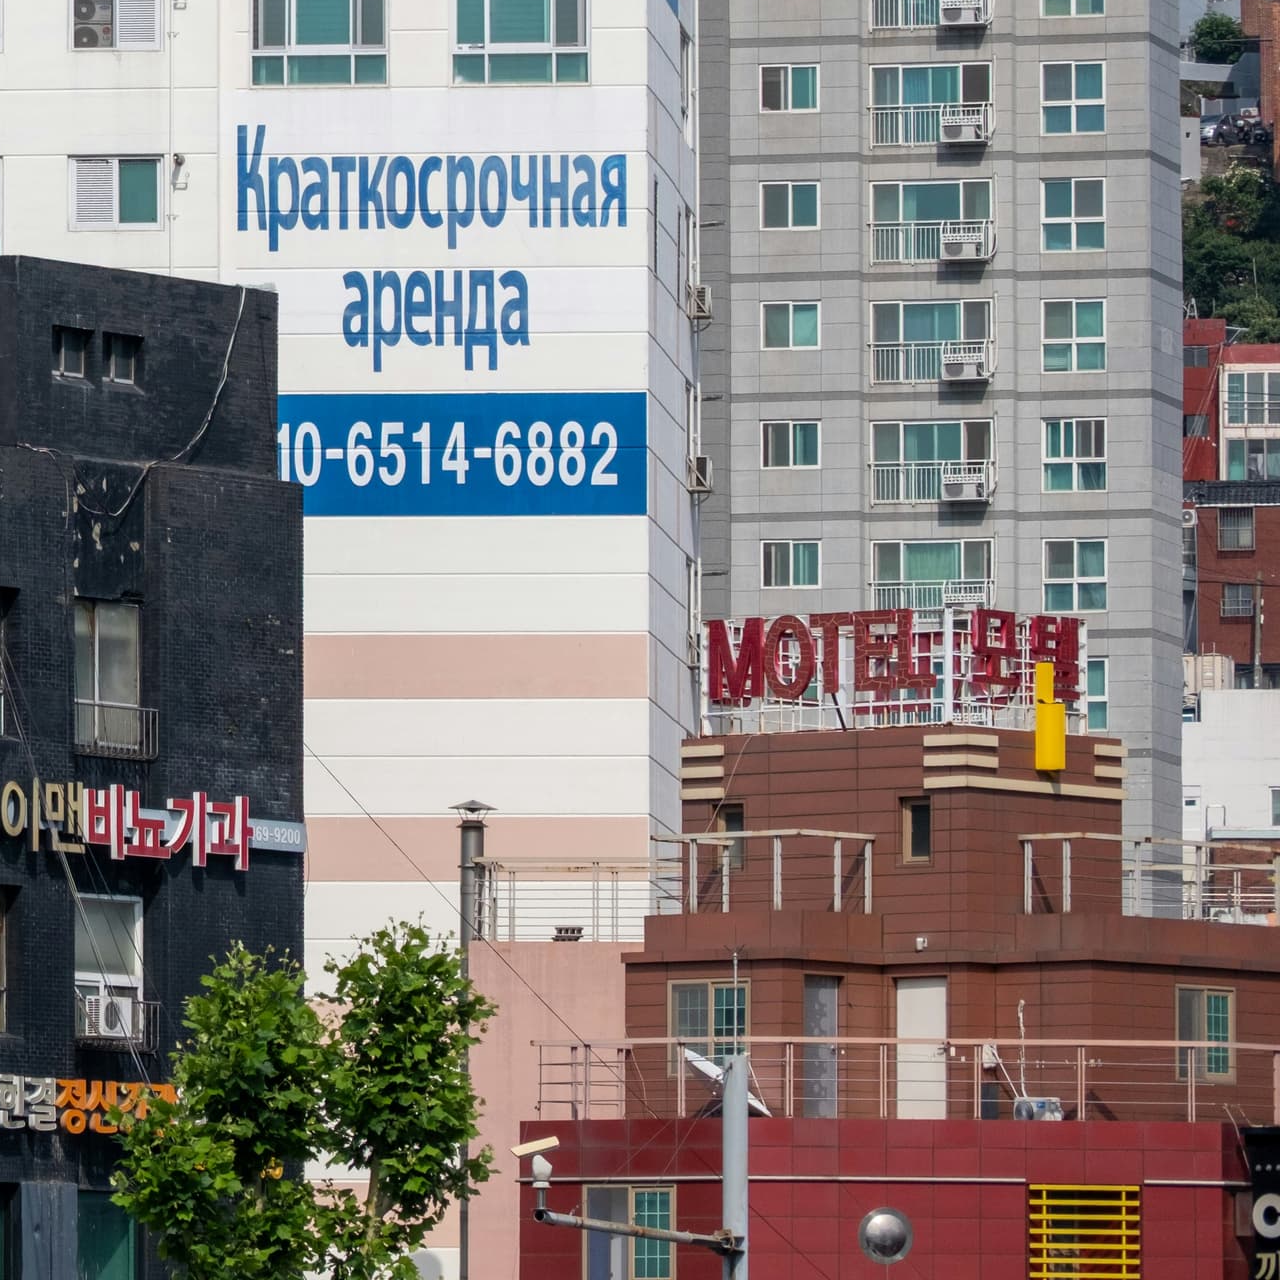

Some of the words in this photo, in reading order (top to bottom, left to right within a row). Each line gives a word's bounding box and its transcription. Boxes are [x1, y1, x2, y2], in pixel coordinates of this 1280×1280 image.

[236, 123, 628, 253] Краткосрочная
[342, 269, 531, 373] аренда
[708, 607, 938, 701] MOTEL
[253, 826, 301, 845] 69-9200
